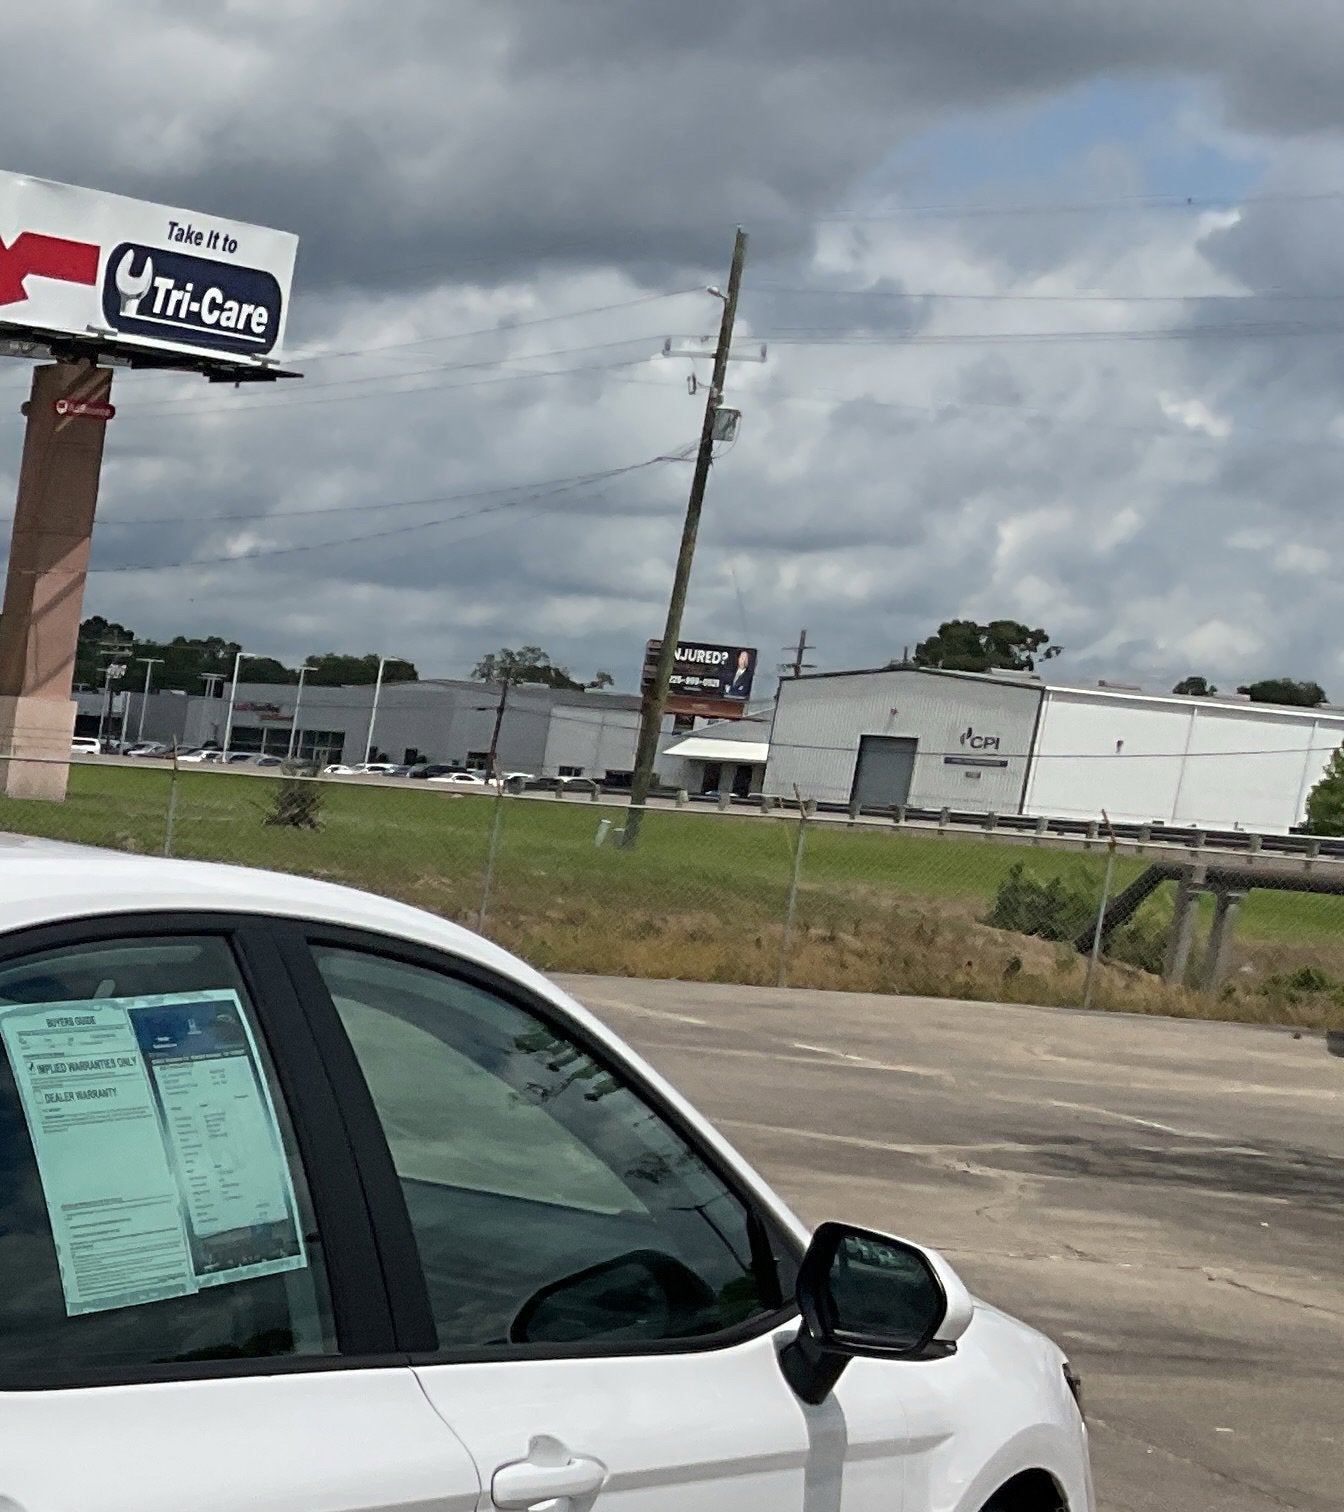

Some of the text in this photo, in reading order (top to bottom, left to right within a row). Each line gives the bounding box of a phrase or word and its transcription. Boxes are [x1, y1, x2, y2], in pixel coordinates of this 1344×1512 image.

[167, 220, 238, 254] Take It to
[152, 276, 269, 334] Tri-Care
[673, 648, 729, 664] NJURED?
[970, 735, 1001, 750] CPI
[45, 1017, 74, 1028] BUYERS
[37, 1062, 68, 1075] IMPLIED
[68, 1058, 117, 1072] WARRANTIES
[116, 1056, 137, 1067] ONLY
[44, 1087, 117, 1104] DEALER WARRANTY
